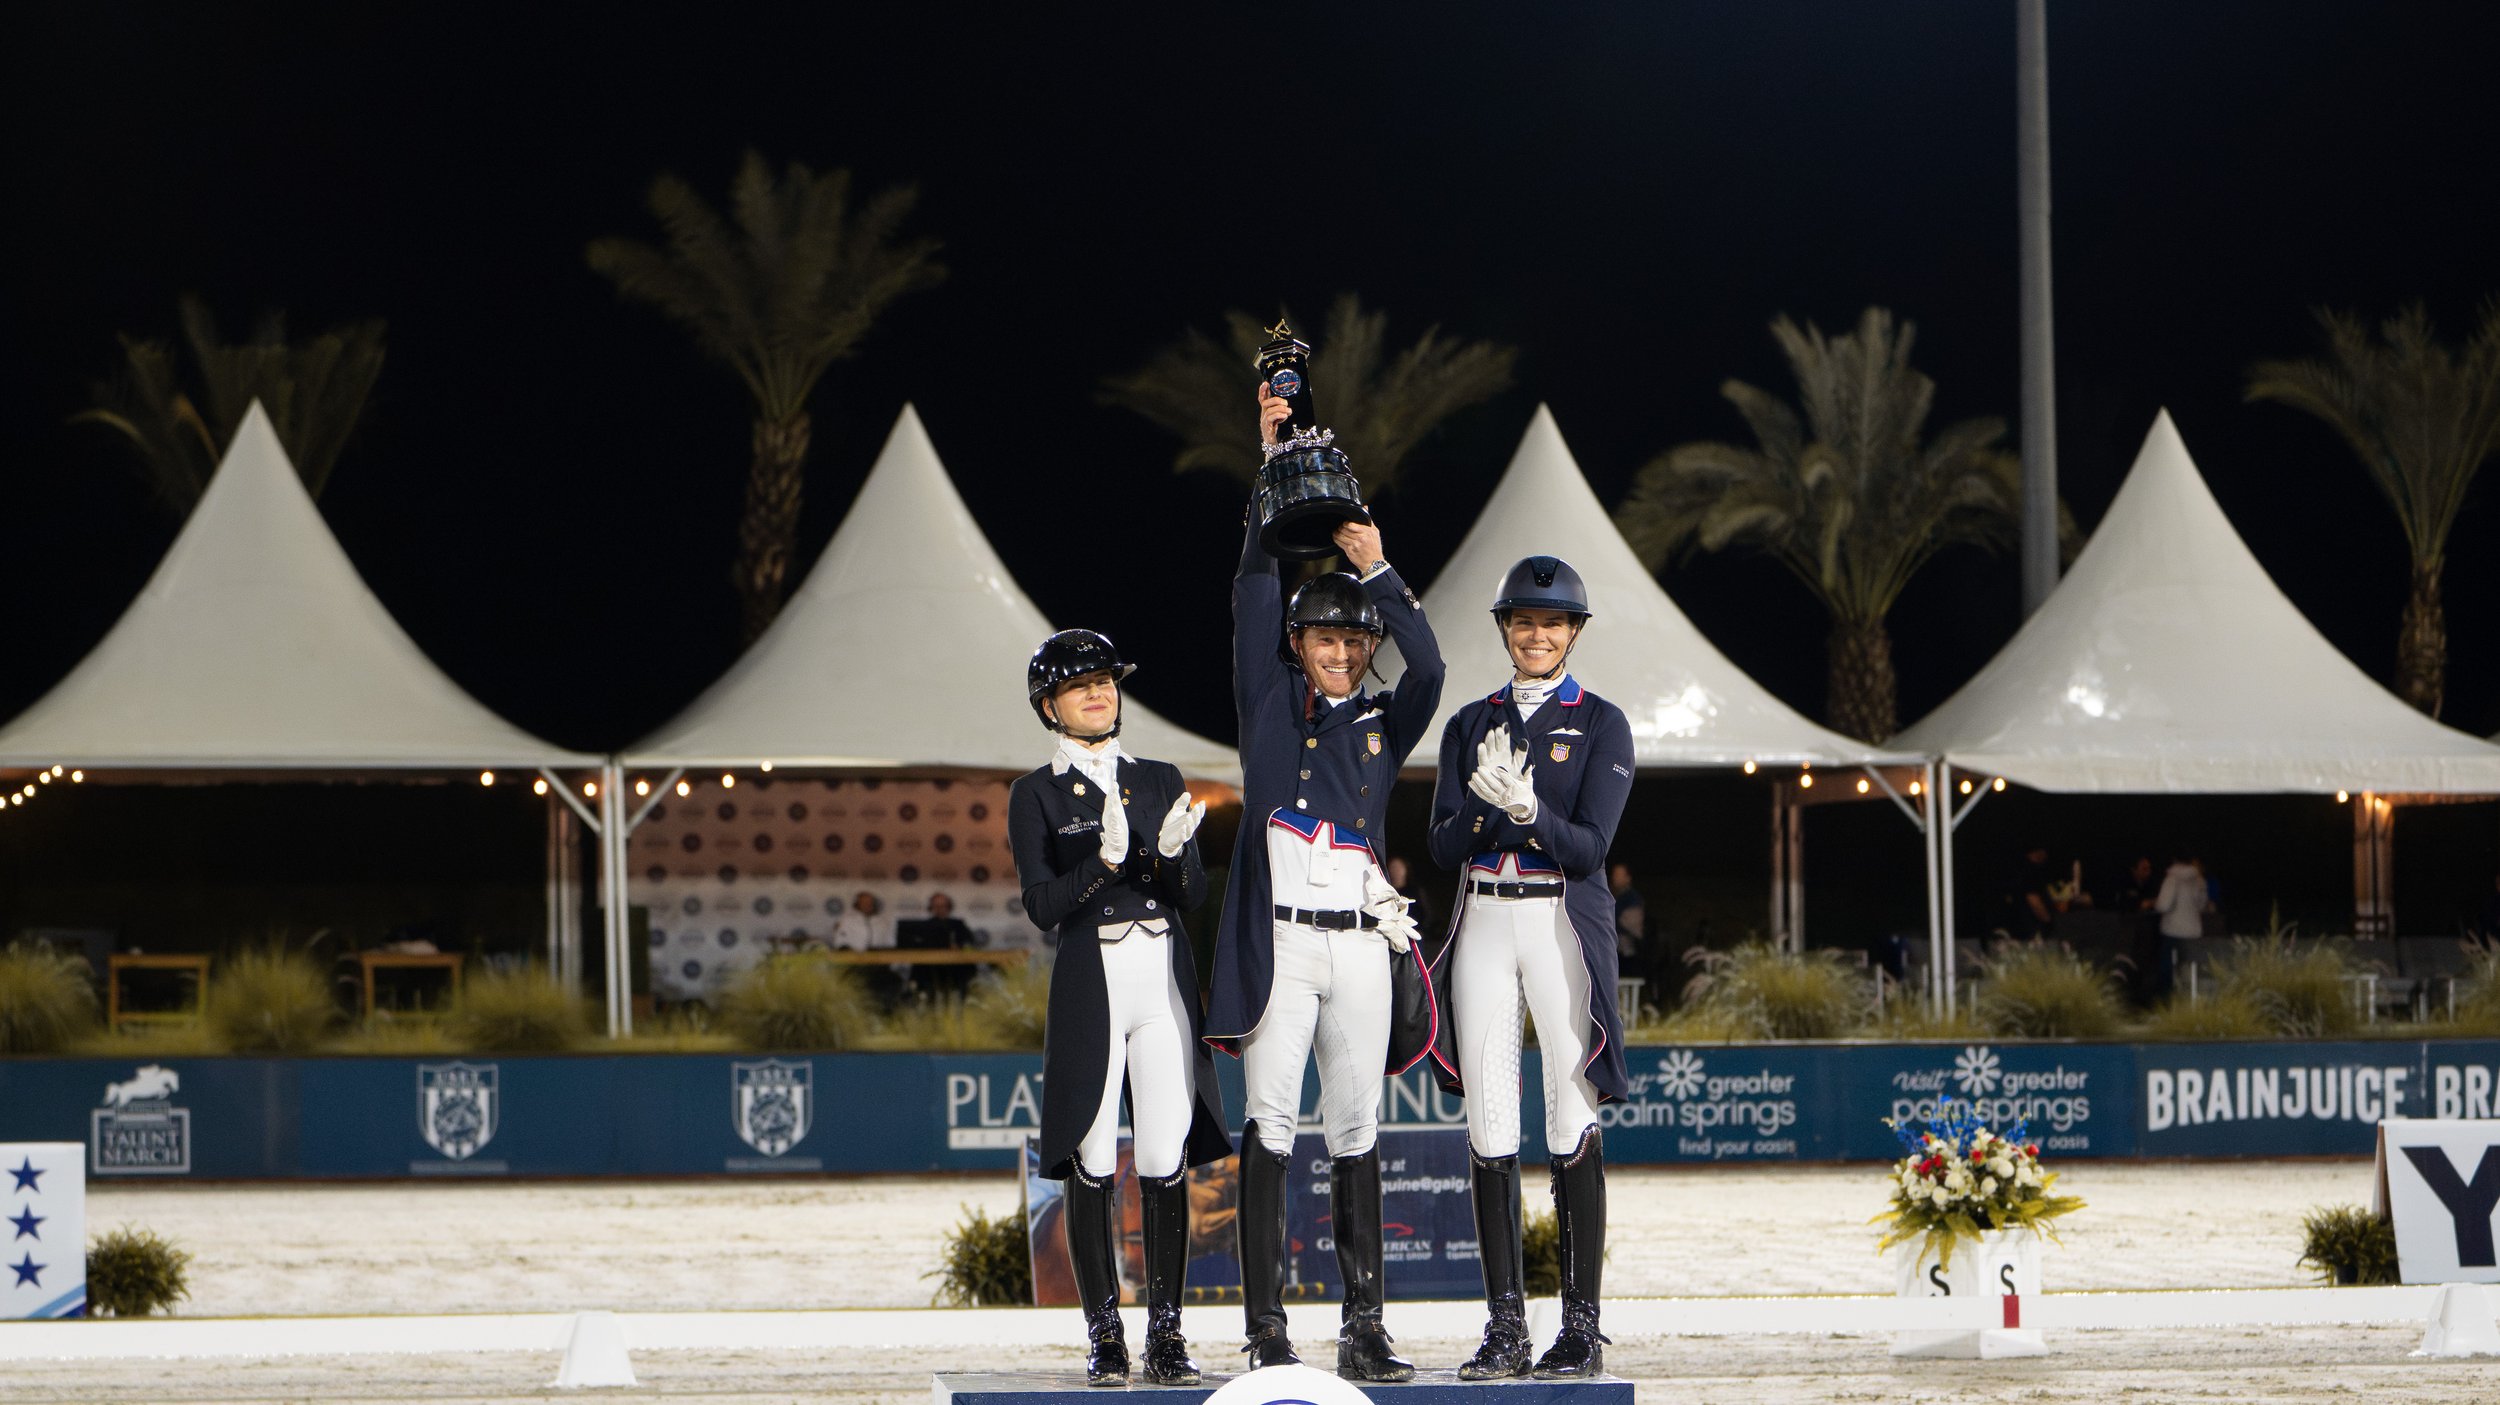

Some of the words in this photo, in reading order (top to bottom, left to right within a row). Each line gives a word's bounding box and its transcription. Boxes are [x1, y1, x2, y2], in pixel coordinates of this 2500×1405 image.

[1057, 820, 1100, 835] EQUESTRIAN
[1707, 1070, 1795, 1100] greater
[1892, 1069, 1950, 1092] visit
[2002, 1065, 2089, 1098] greater
[1978, 1093, 2091, 1133] springs
[2148, 1067, 2407, 1132] BRAINJUICE
[1680, 1097, 1796, 1137] springs
[1714, 1140, 1750, 1159] your
[1753, 1138, 1796, 1154] oasis
[2047, 1134, 2090, 1150] oasis
[1390, 1159, 1406, 1172] at
[1383, 1240, 1432, 1252] ERICAN
[1929, 1264, 1951, 1296] S
[2000, 1264, 2015, 1295] S
